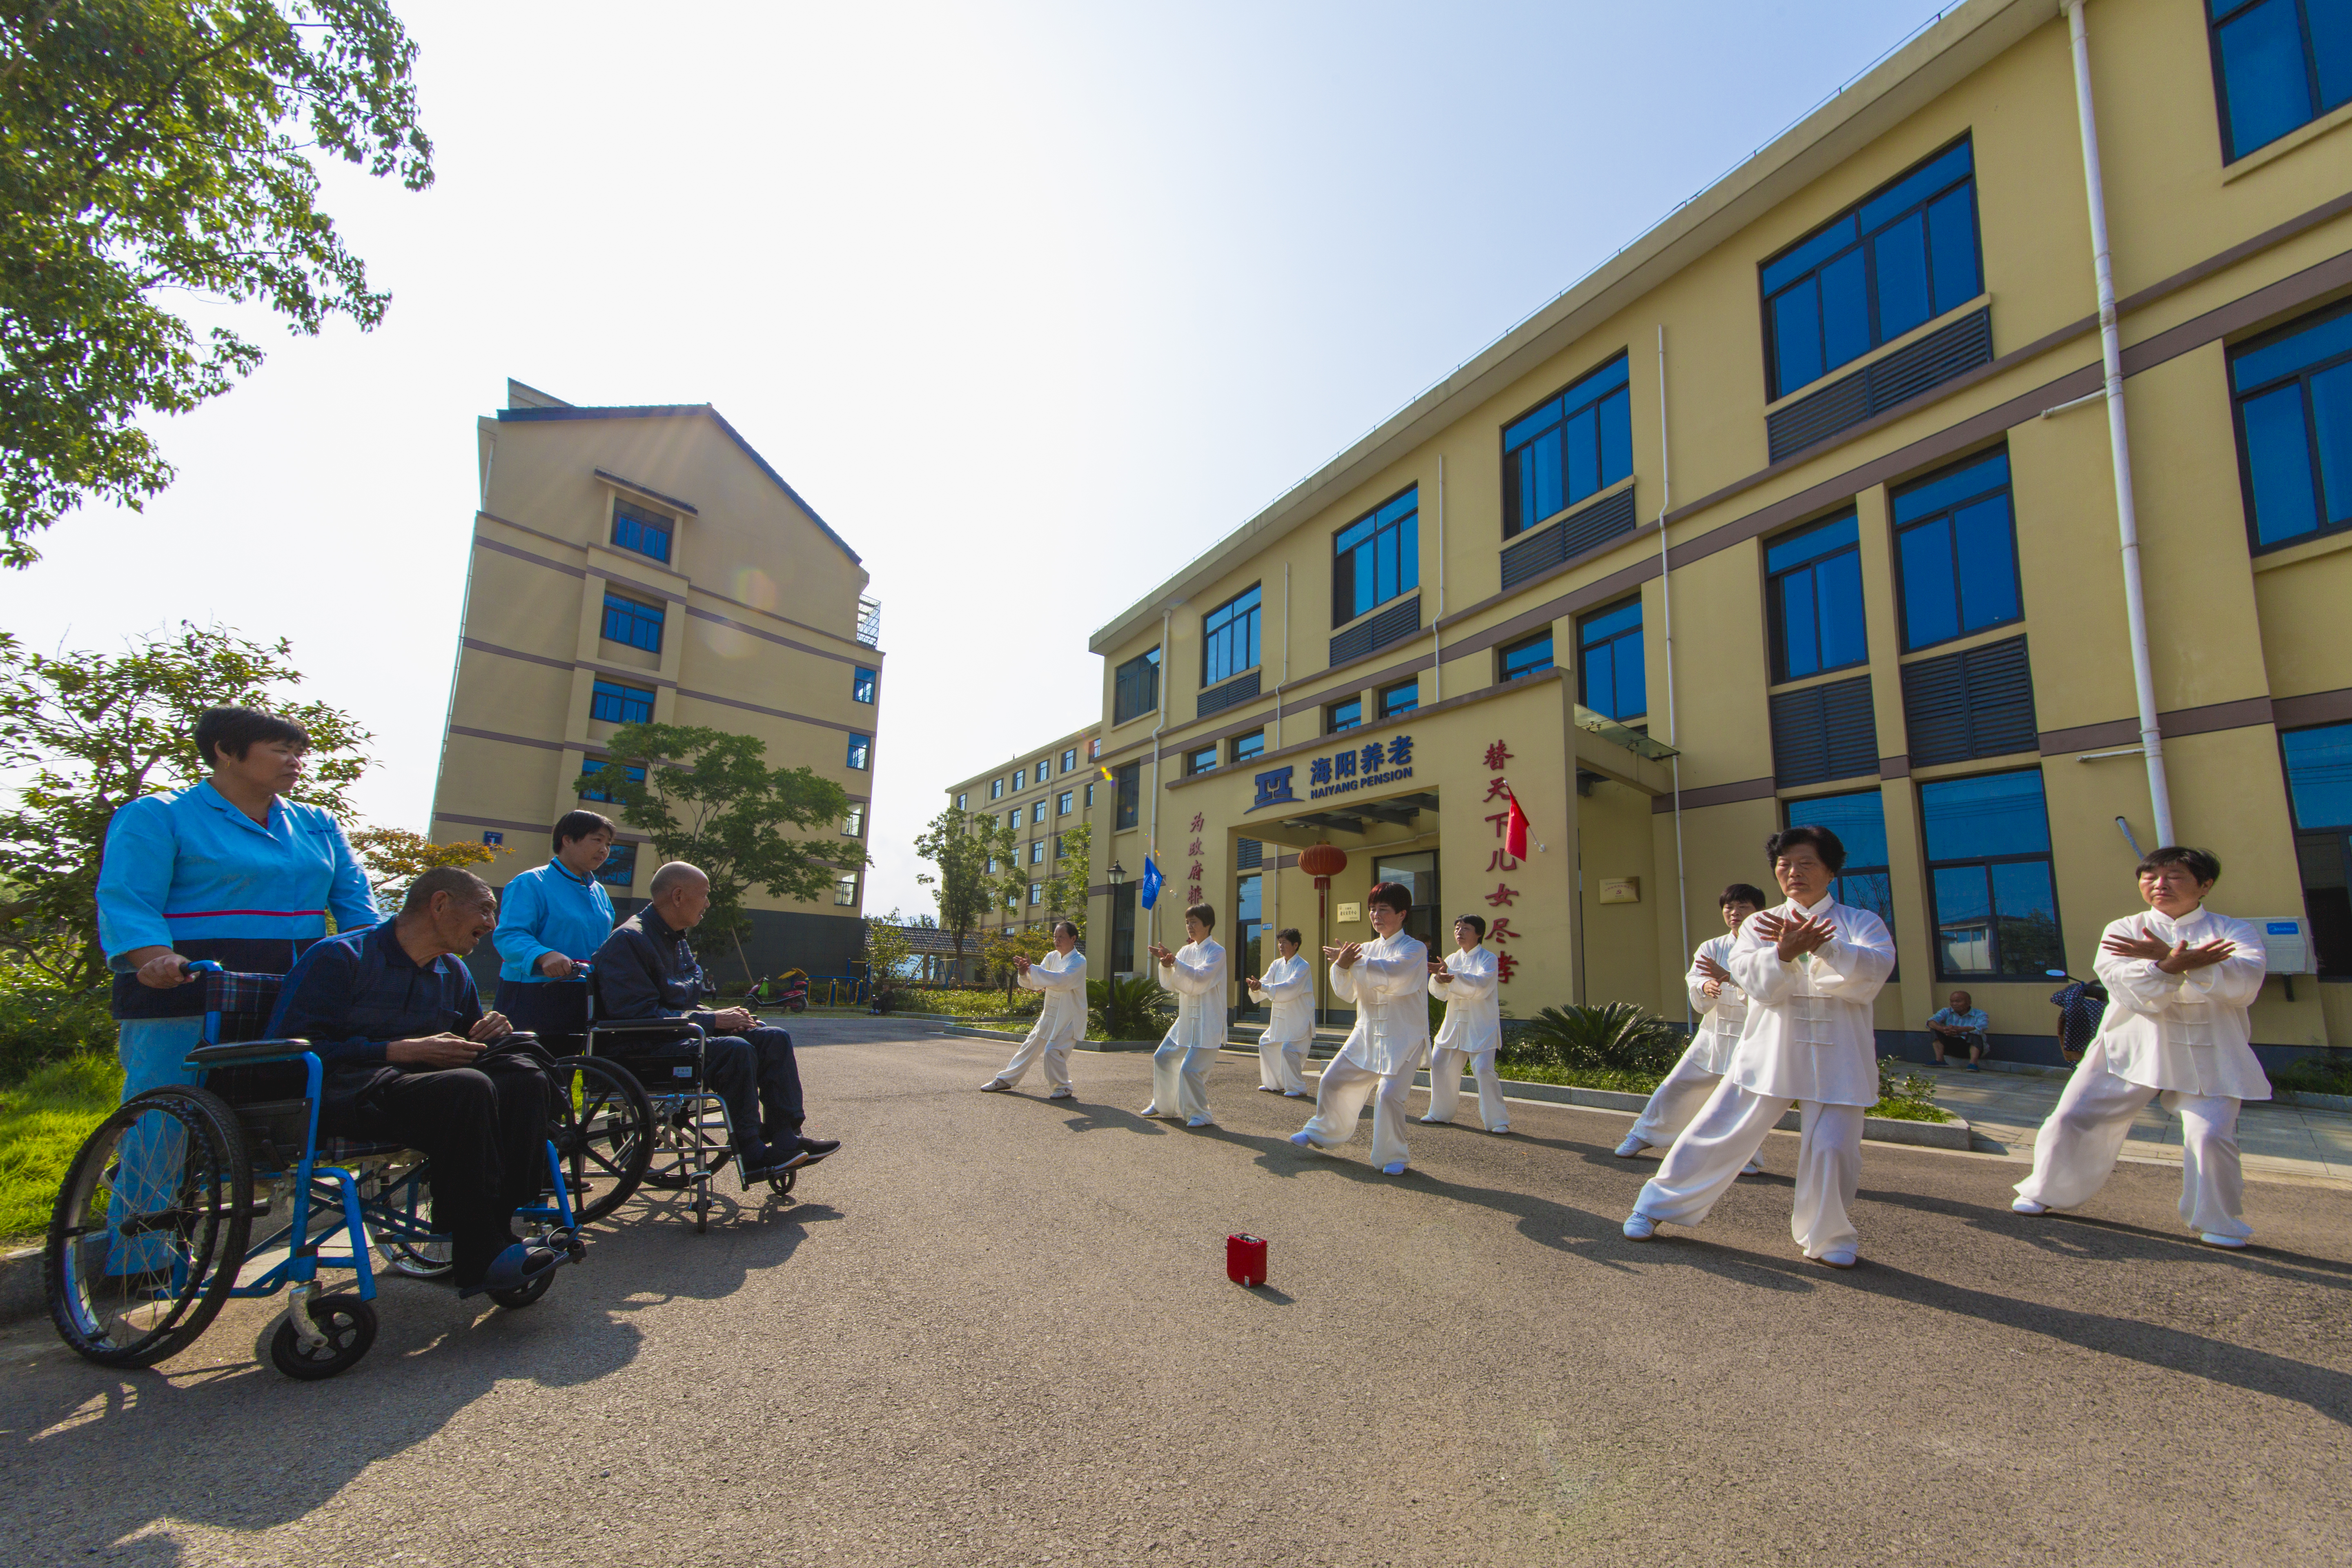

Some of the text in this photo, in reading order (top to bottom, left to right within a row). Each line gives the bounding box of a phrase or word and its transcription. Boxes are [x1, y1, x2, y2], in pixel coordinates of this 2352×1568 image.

[1310, 735, 1413, 786] 海阳养老
[1310, 766, 1412, 799] HAIYANG PENSION
[1187, 811, 1204, 944] 为政府排
[1483, 739, 1521, 984] 替天下儿女尽孝
